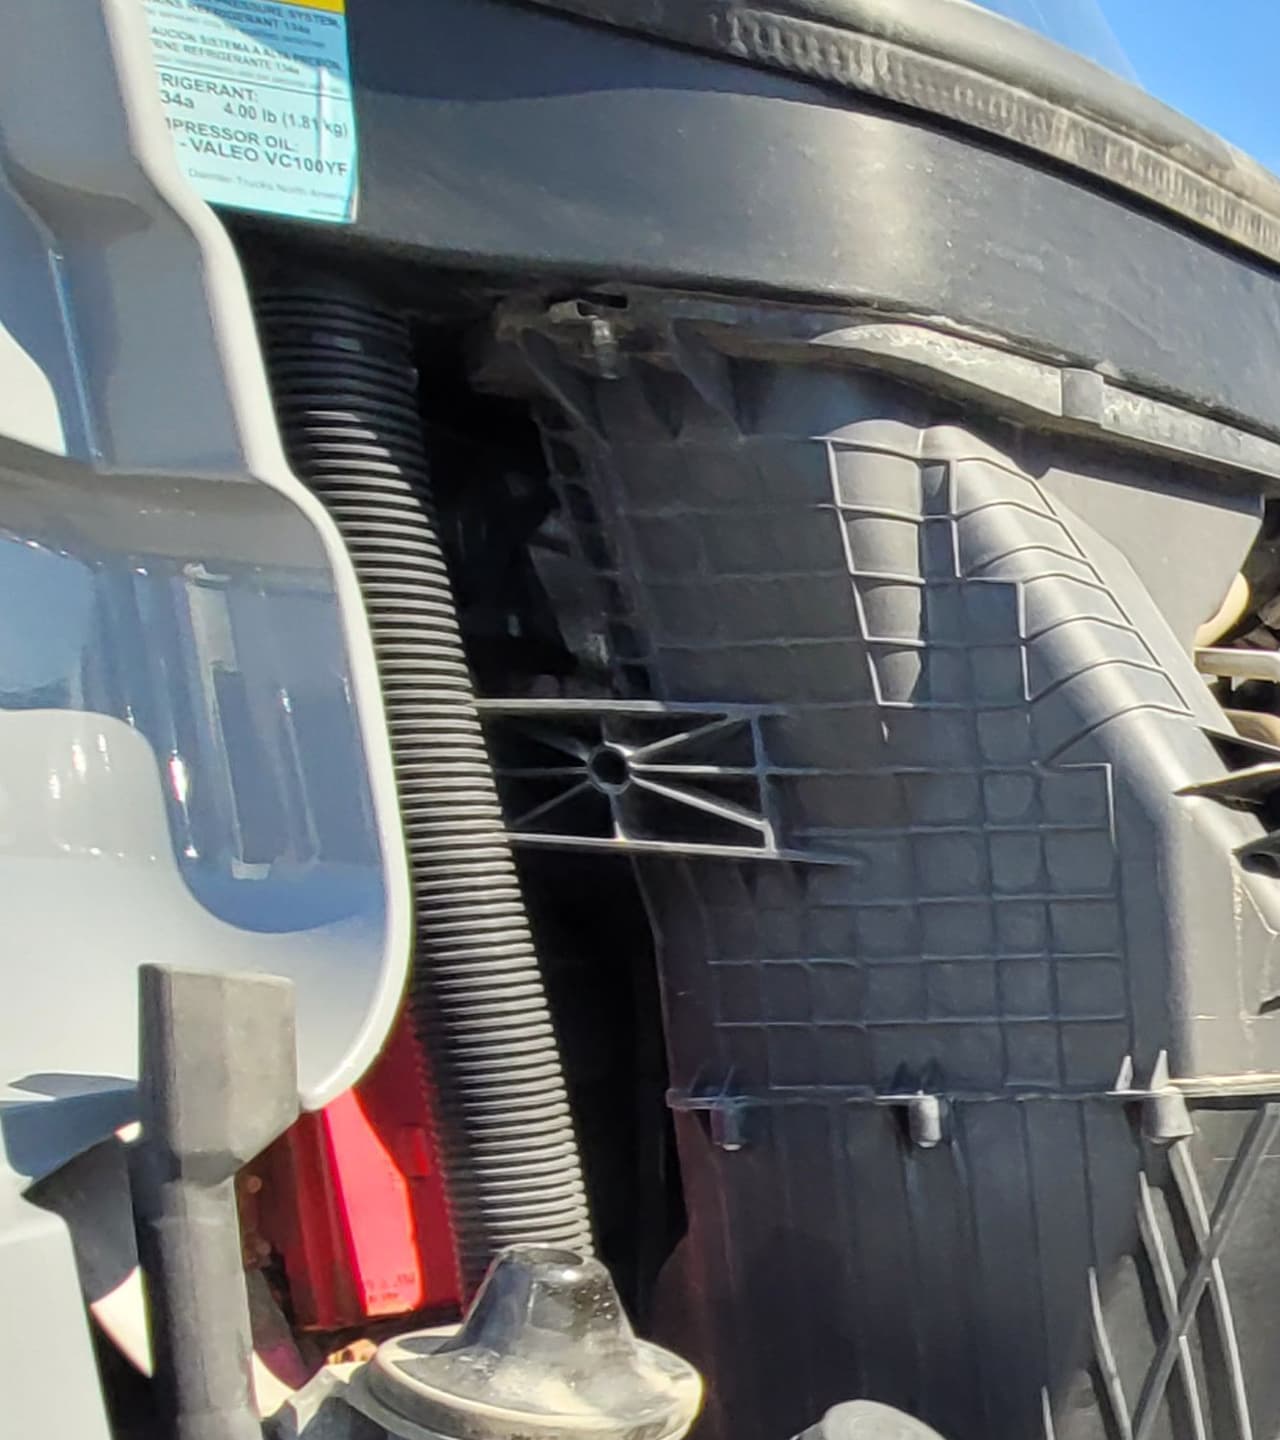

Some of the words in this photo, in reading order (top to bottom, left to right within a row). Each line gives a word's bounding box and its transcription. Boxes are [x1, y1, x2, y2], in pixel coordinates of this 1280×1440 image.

[164, 116, 260, 147] PRESSOR
[223, 102, 258, 121] 4.00
[262, 108, 278, 124] lb
[281, 111, 321, 131] (1.81
[323, 119, 349, 138] kg)
[188, 137, 260, 162] VALEO
[263, 151, 349, 177] VC100YF
